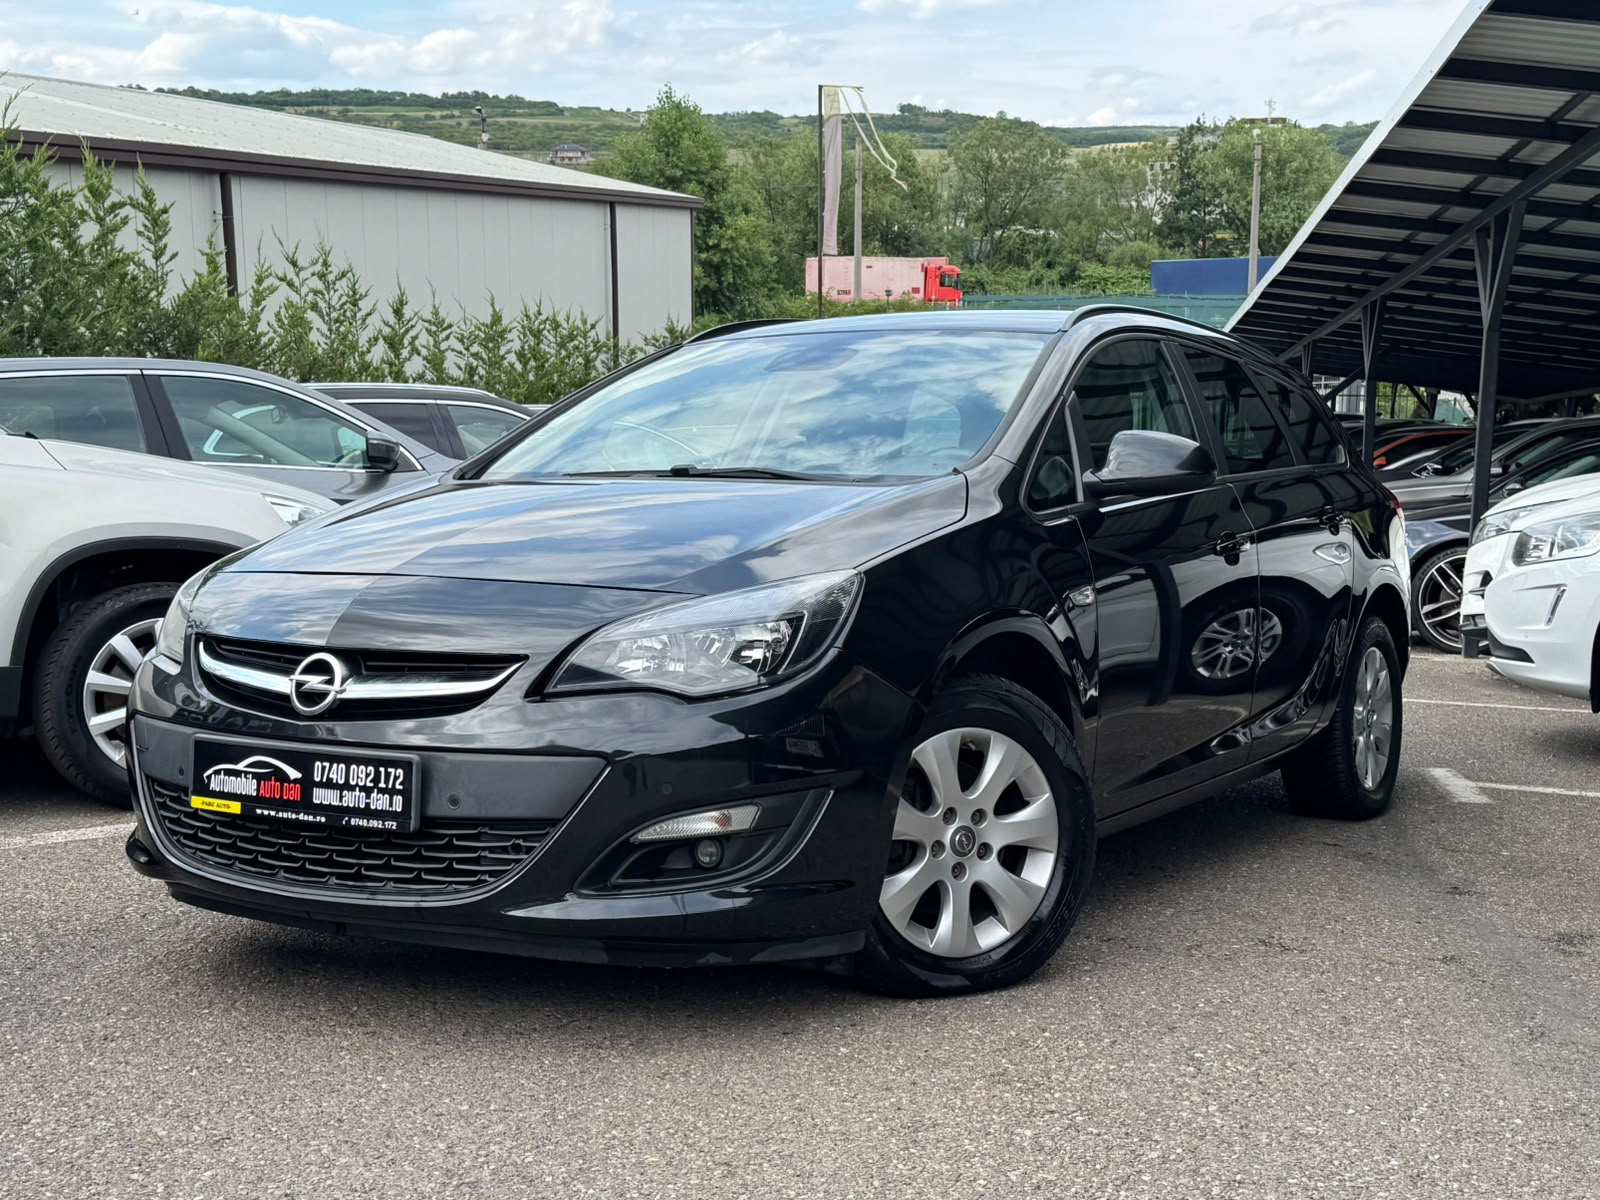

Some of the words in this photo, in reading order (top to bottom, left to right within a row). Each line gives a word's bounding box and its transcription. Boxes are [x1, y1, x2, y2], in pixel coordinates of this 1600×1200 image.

[209, 770, 257, 796] Automobile
[314, 761, 346, 784] 0740
[349, 764, 375, 787] 092
[378, 766, 404, 790] 172
[313, 786, 403, 812] www.auto-dan.ro
[255, 808, 326, 823] www.auto-dan.ro
[350, 817, 397, 830] 0740.092.172
